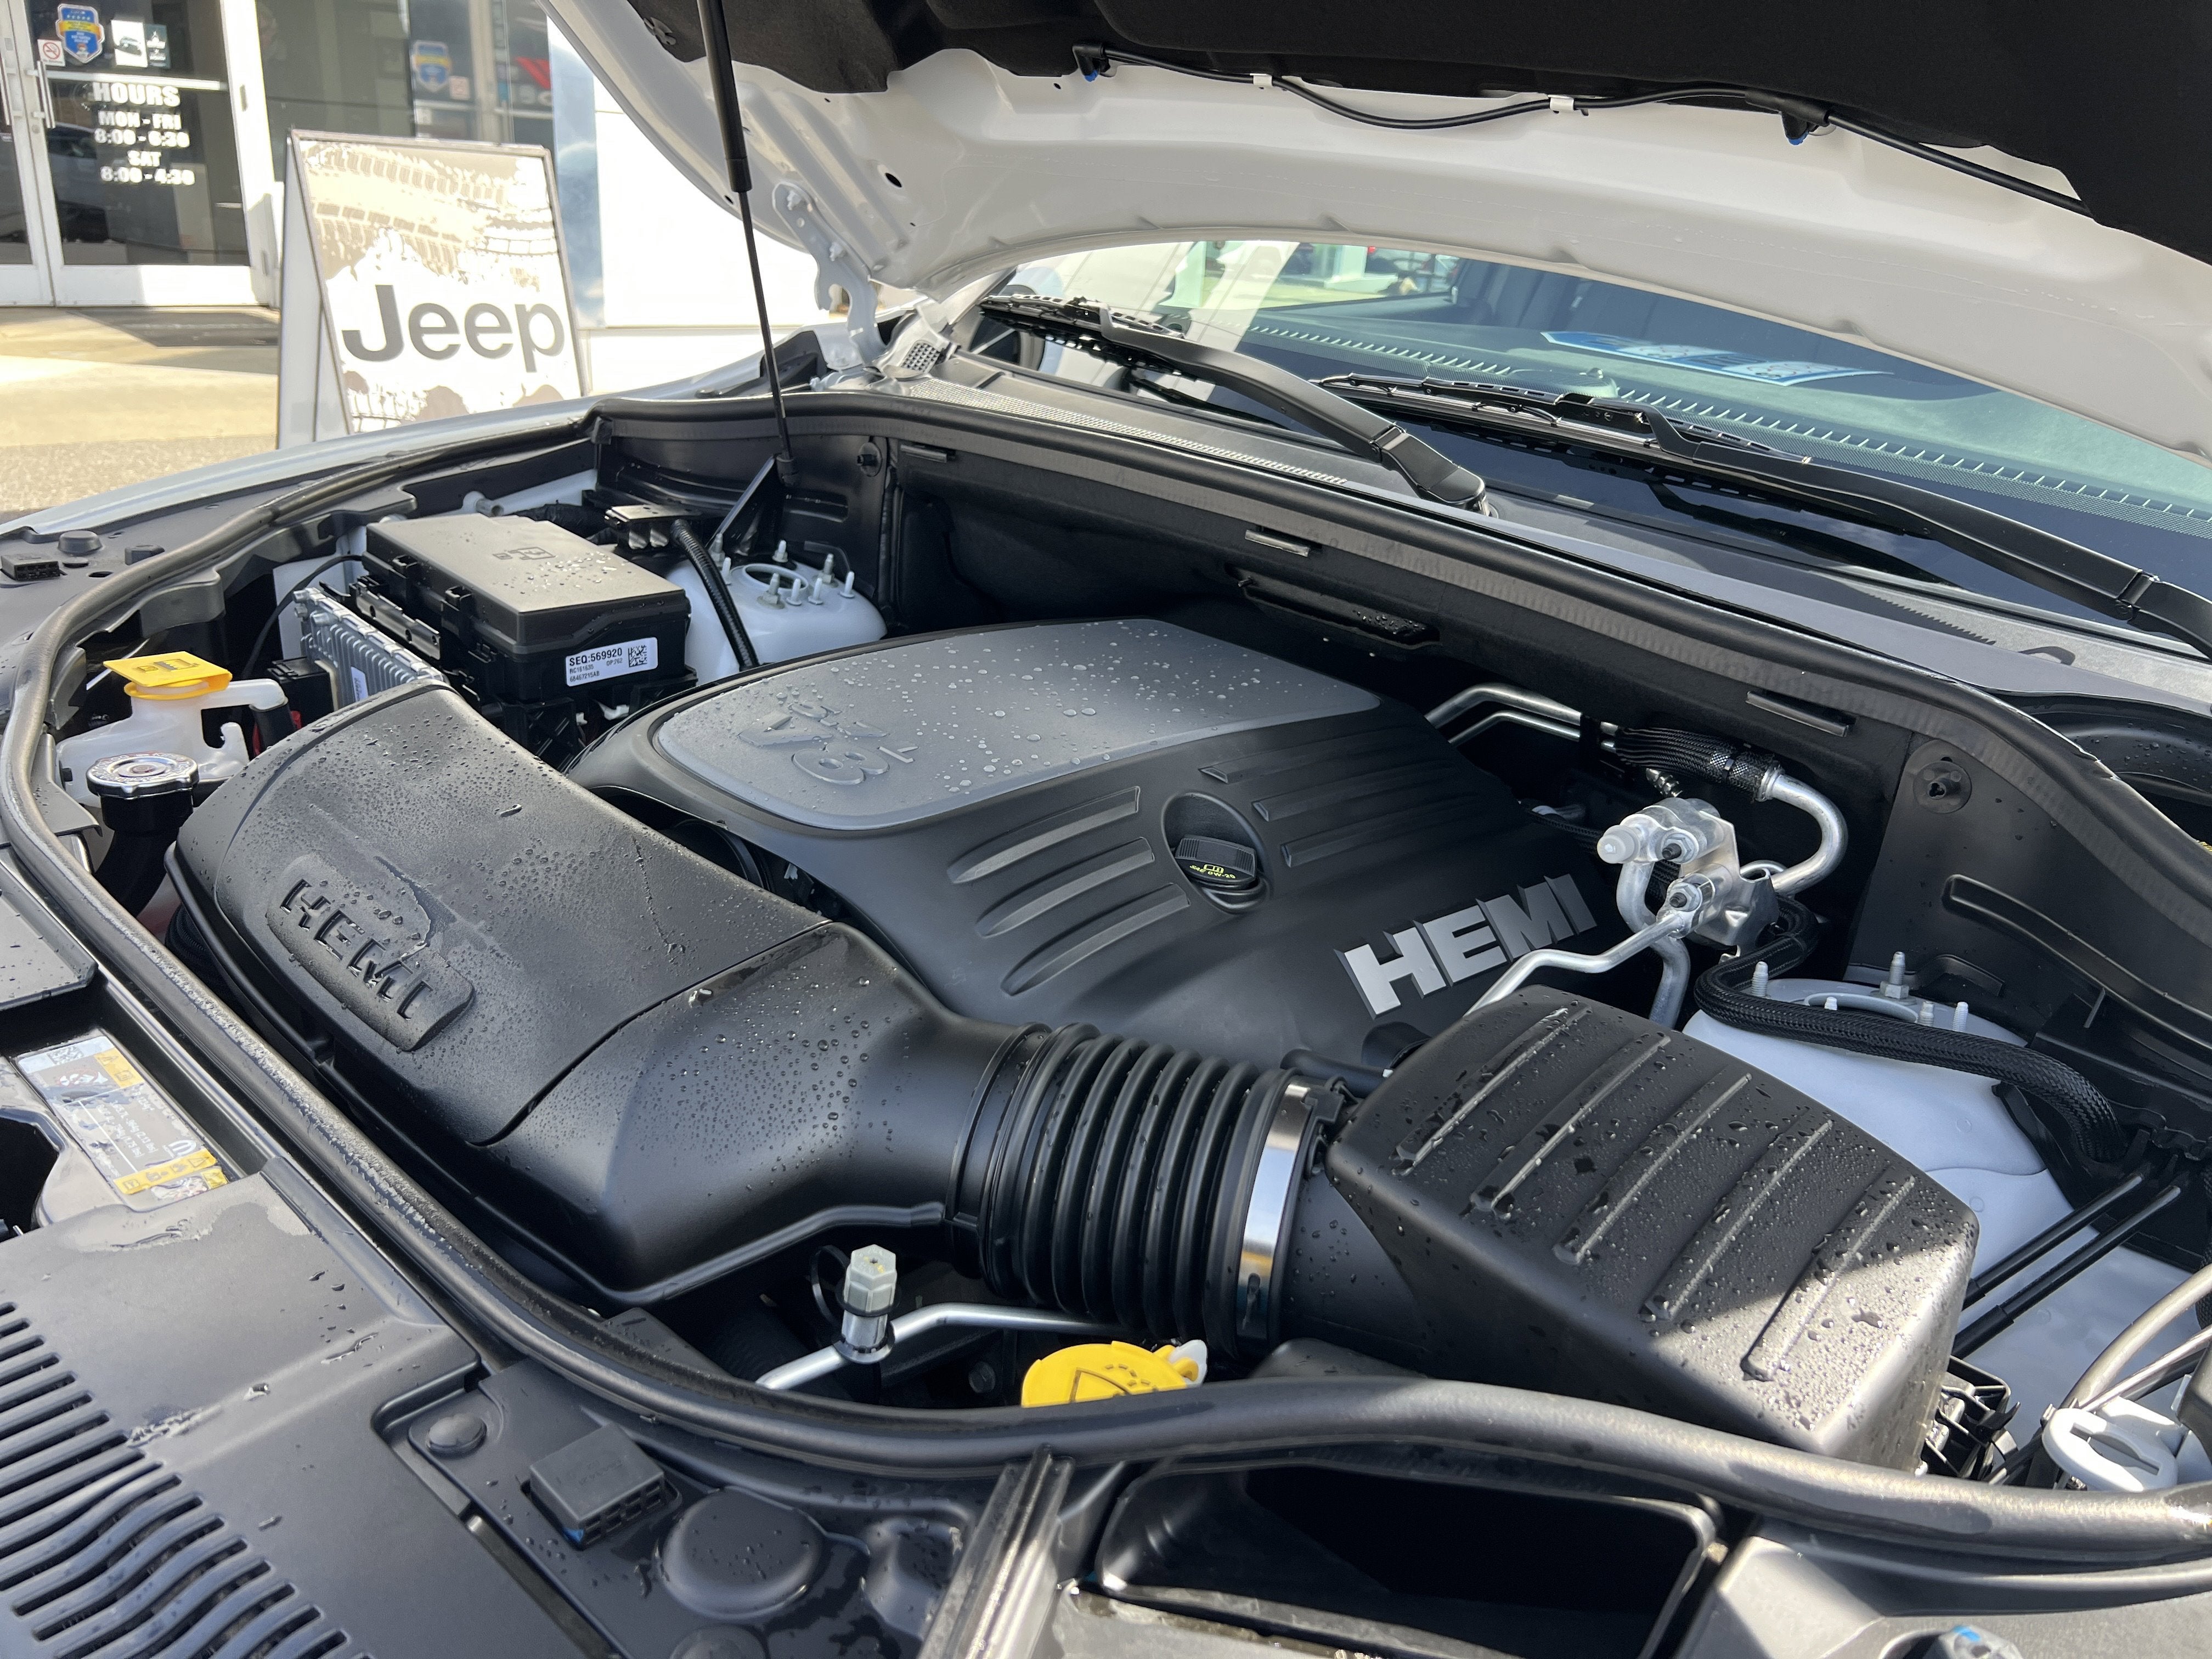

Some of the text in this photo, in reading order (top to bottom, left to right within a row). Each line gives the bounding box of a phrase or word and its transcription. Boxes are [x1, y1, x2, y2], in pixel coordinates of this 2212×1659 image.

[92, 82, 180, 107] HOURS
[127, 150, 161, 167] SAT
[342, 284, 565, 373] Jeep
[569, 647, 623, 667] SEQ:569920
[737, 708, 891, 785] V8
[280, 878, 433, 1021] HEMI
[1333, 873, 1598, 1022] HEMI
